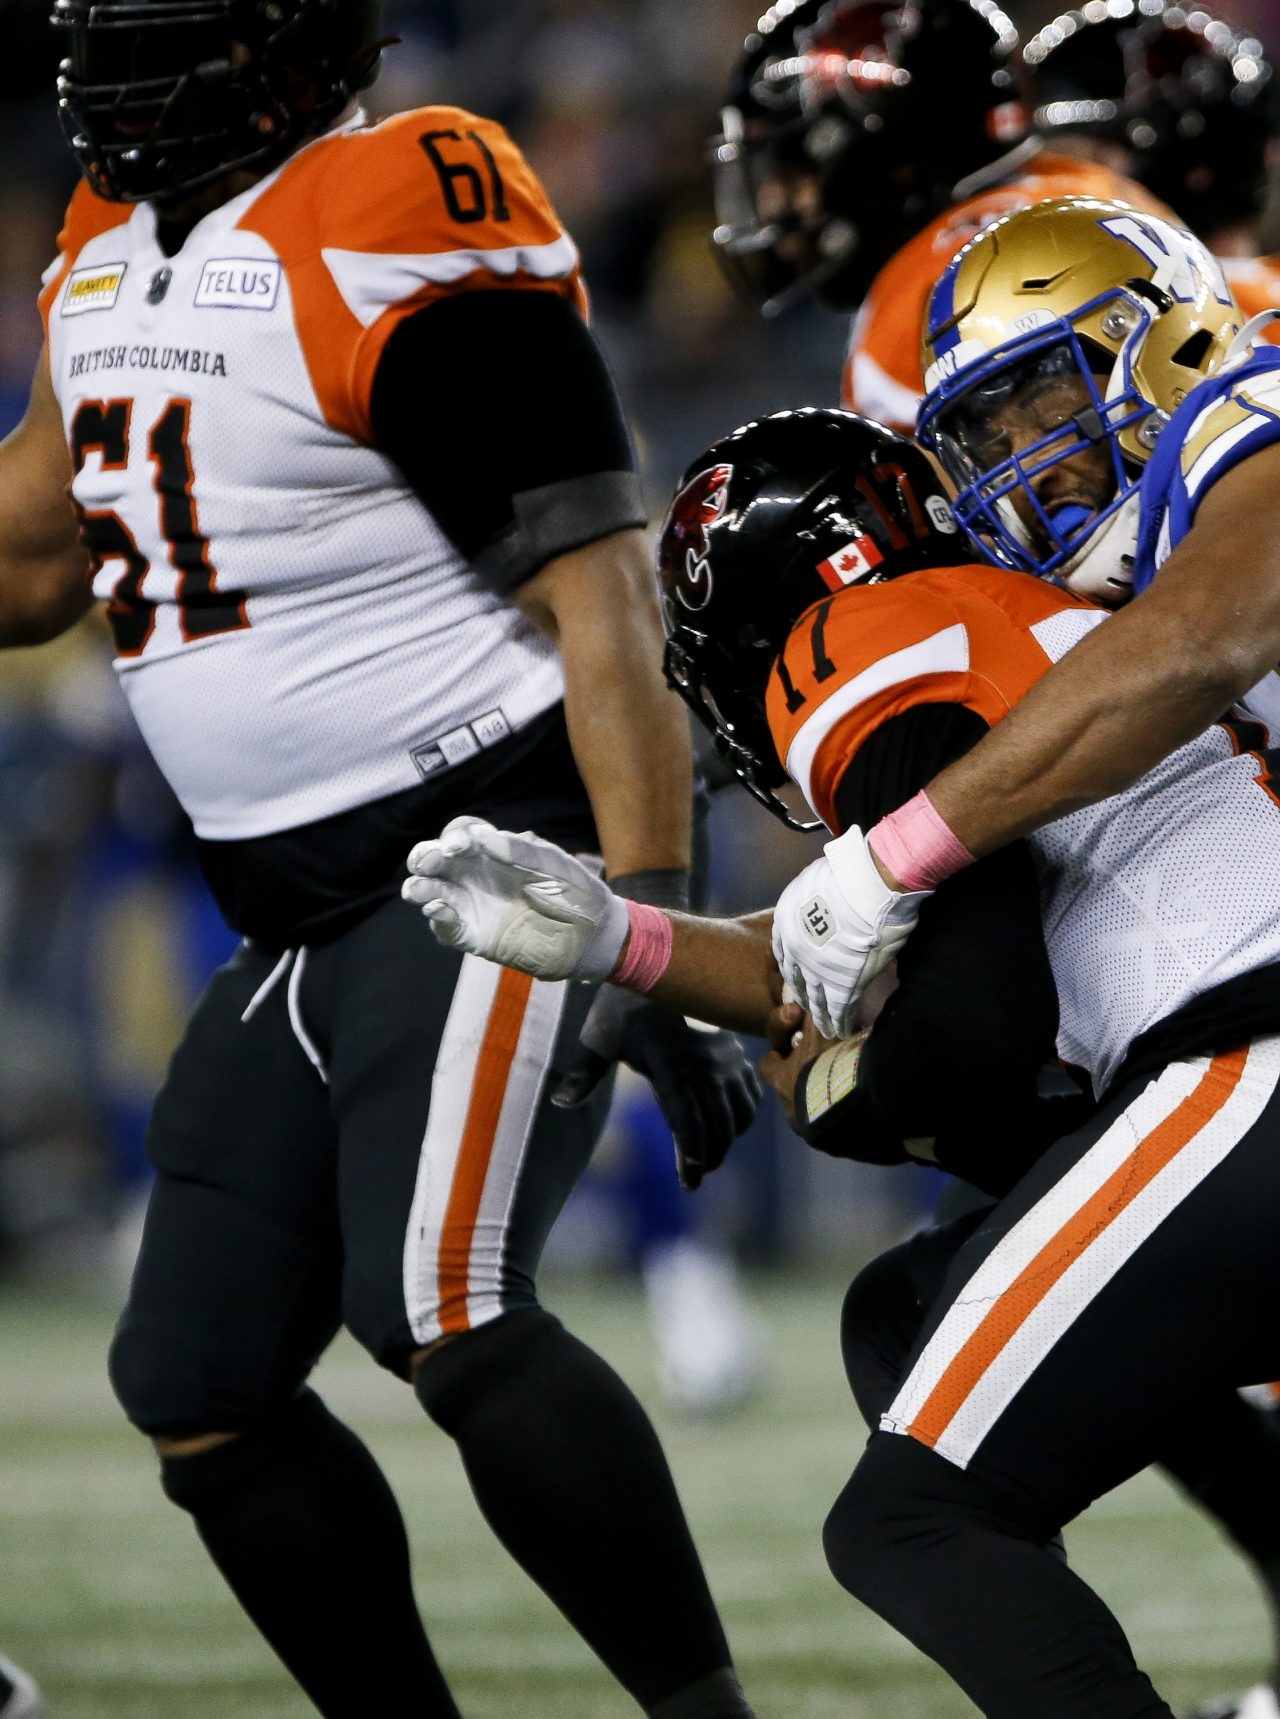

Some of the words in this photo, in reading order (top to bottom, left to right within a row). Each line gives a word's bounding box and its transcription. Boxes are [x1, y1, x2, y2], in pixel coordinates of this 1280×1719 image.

[418, 130, 512, 223] 61
[204, 270, 272, 296] TELUS
[69, 345, 128, 379] BRITISH
[129, 345, 228, 378] COLUMBIA
[71, 396, 252, 658] 61
[854, 462, 930, 551] 17
[776, 597, 838, 715] 17
[807, 902, 829, 937] CFL
